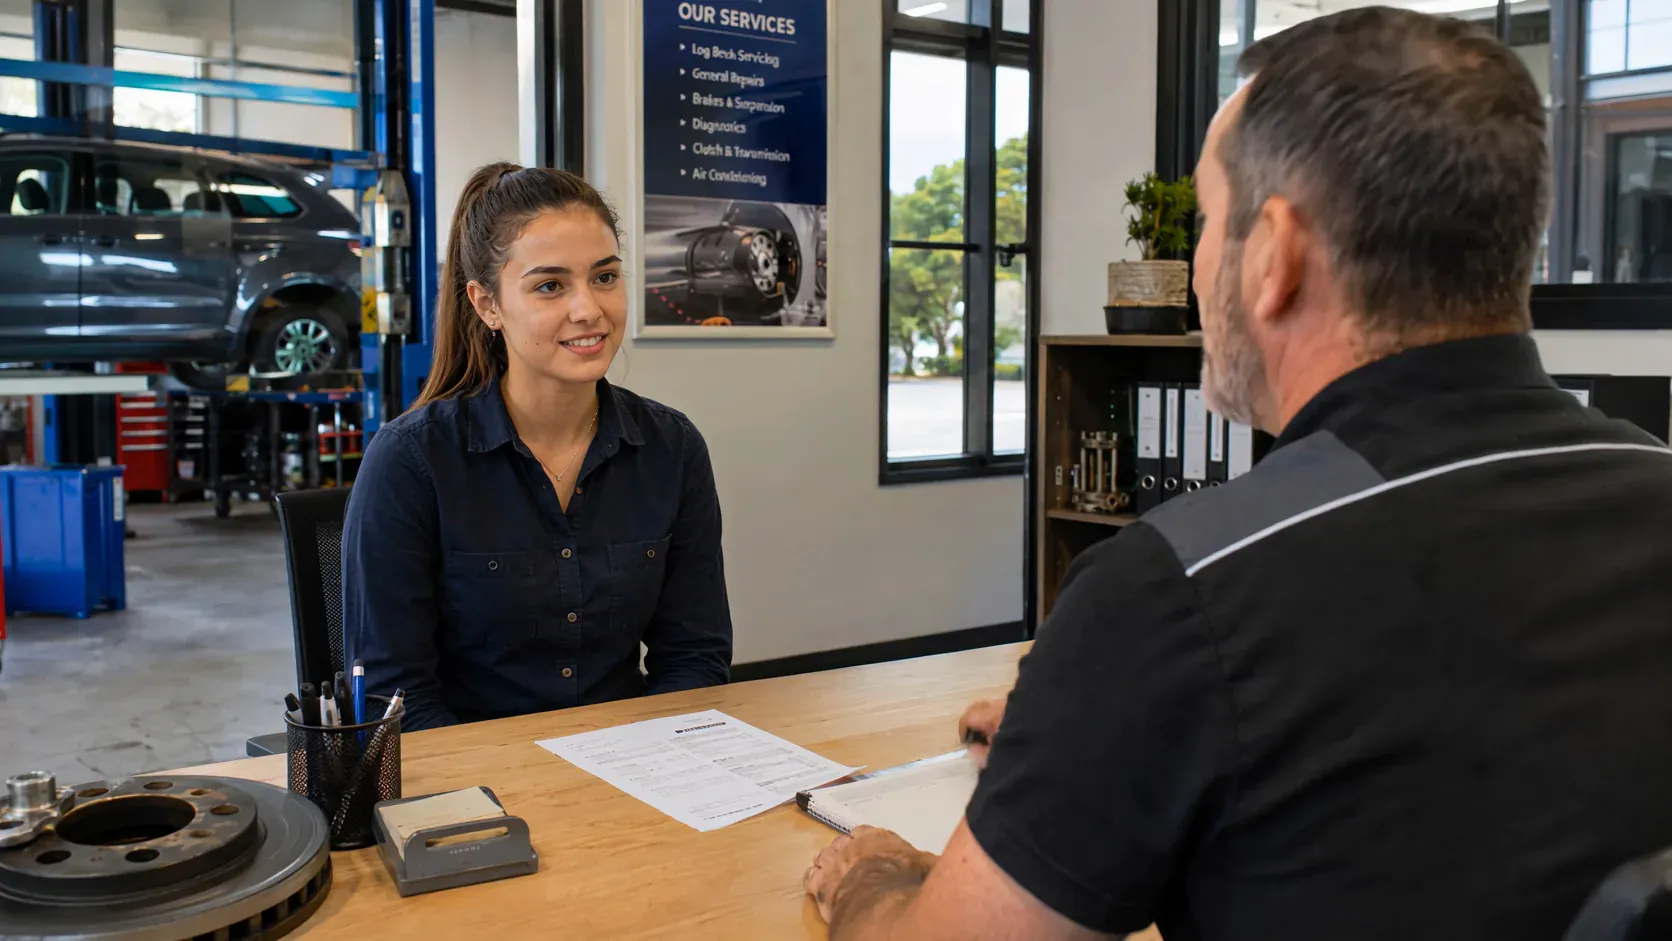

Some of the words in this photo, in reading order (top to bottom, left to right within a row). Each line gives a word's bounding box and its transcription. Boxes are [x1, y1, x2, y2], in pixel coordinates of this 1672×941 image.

[678, 2, 716, 24] OUR
[719, 9, 796, 35] SERVICES
[692, 43, 711, 59] Log
[692, 167, 707, 180] Air
